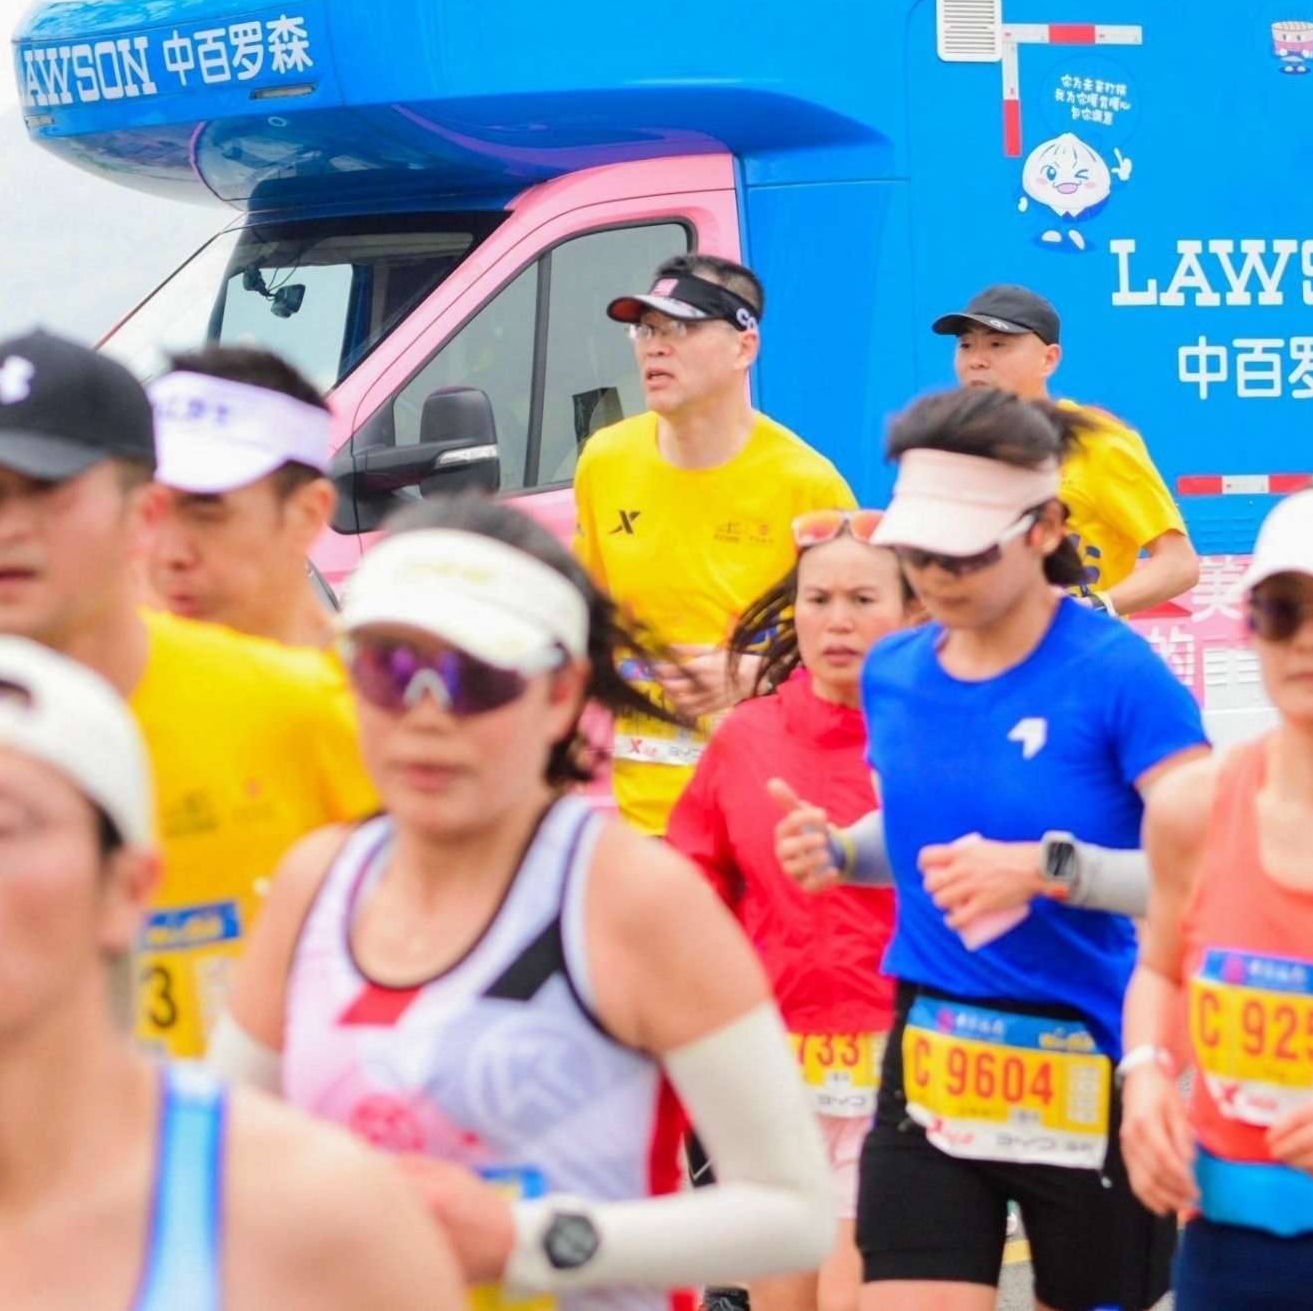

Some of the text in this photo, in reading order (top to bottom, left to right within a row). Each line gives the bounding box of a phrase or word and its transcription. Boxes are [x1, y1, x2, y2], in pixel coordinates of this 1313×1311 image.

[162, 14, 314, 86] 中百罗森
[1199, 991, 1220, 1047] C
[913, 1037, 931, 1088] C
[946, 1046, 1054, 1105] 9604
